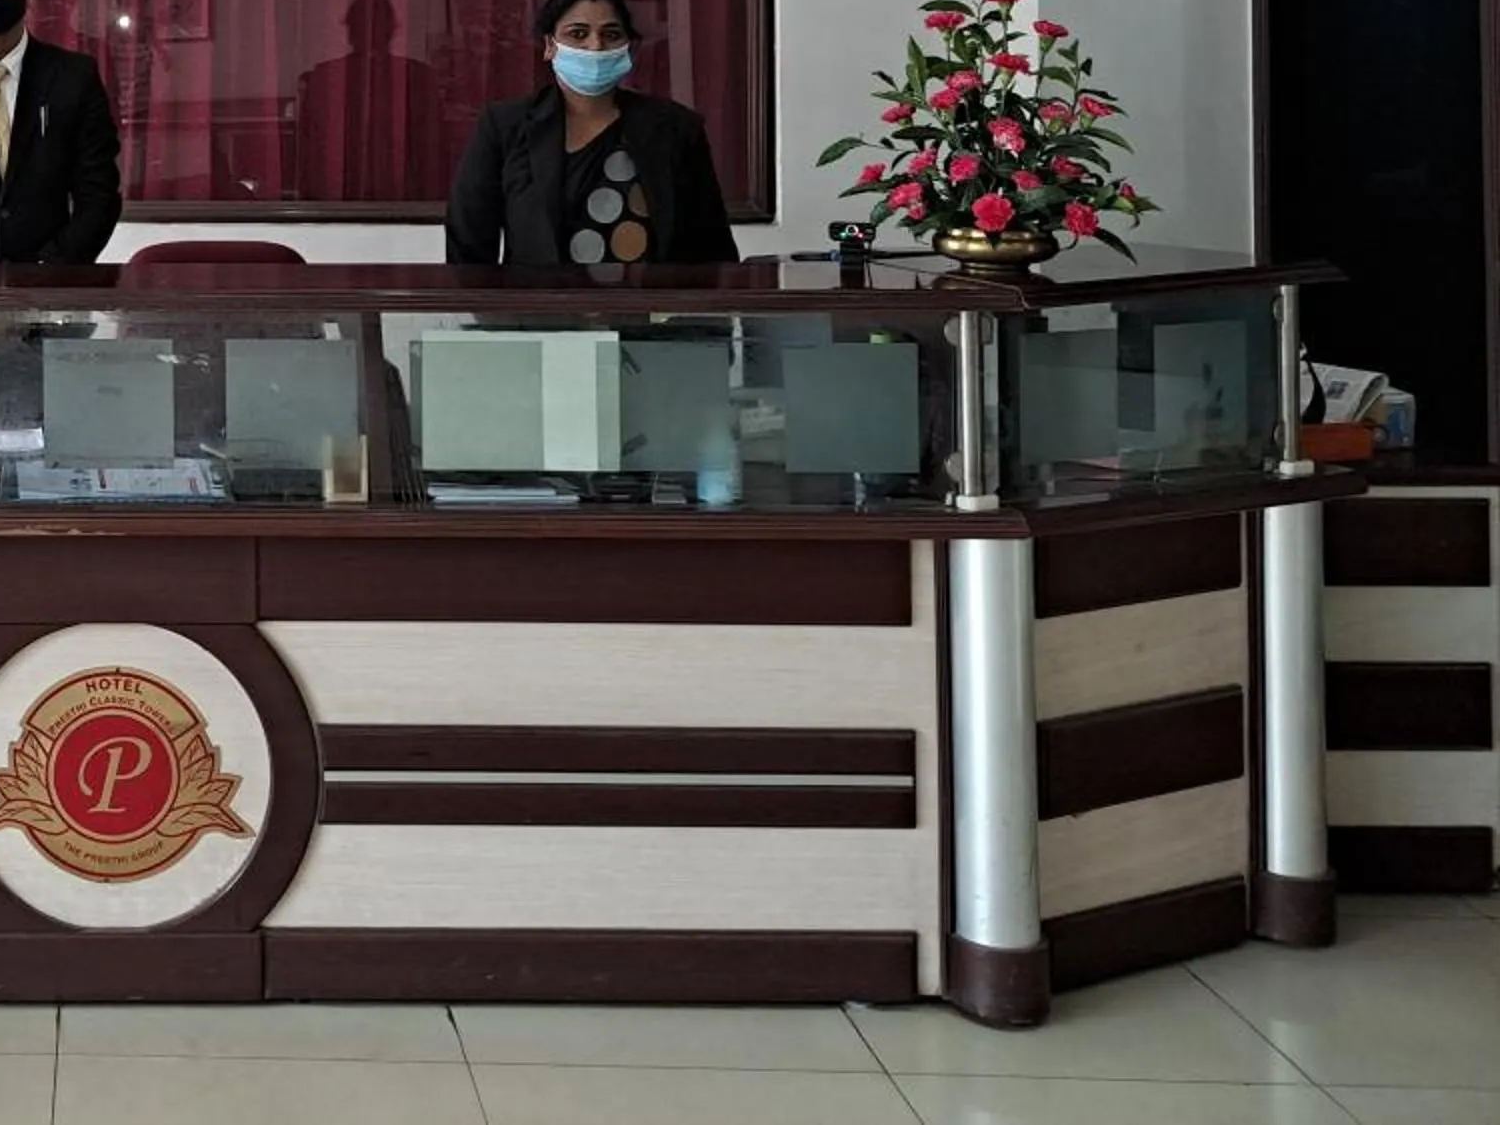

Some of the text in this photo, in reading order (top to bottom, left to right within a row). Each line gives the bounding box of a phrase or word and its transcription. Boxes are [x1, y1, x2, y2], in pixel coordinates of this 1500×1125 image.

[85, 678, 143, 695] HOTEL
[89, 695, 135, 707] CLASSIC
[77, 735, 153, 814] P
